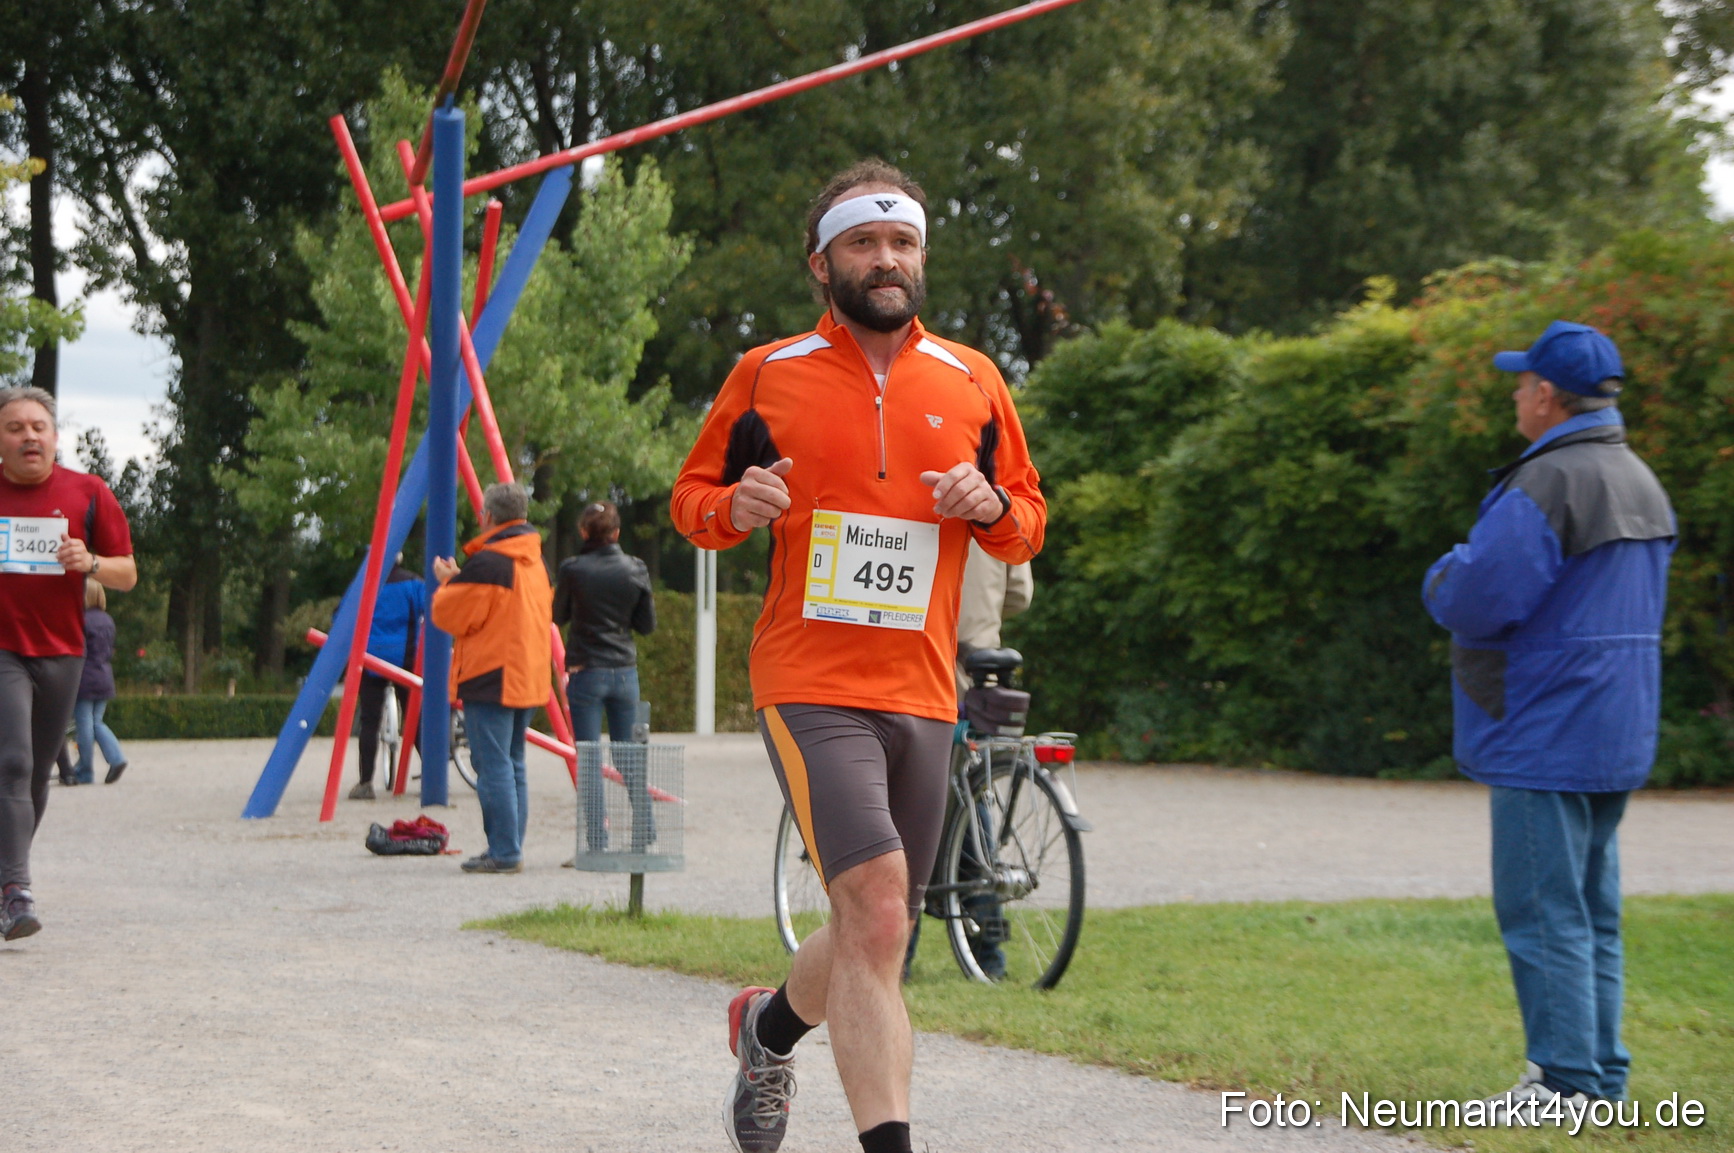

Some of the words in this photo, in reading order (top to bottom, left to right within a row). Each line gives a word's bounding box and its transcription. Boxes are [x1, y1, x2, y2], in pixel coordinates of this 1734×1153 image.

[15, 523, 40, 533] Anton
[846, 525, 908, 551] Michael
[15, 539, 58, 553] 3402
[814, 553, 822, 568] D
[853, 561, 915, 594] 495
[883, 611, 924, 623] PFLEIDERER
